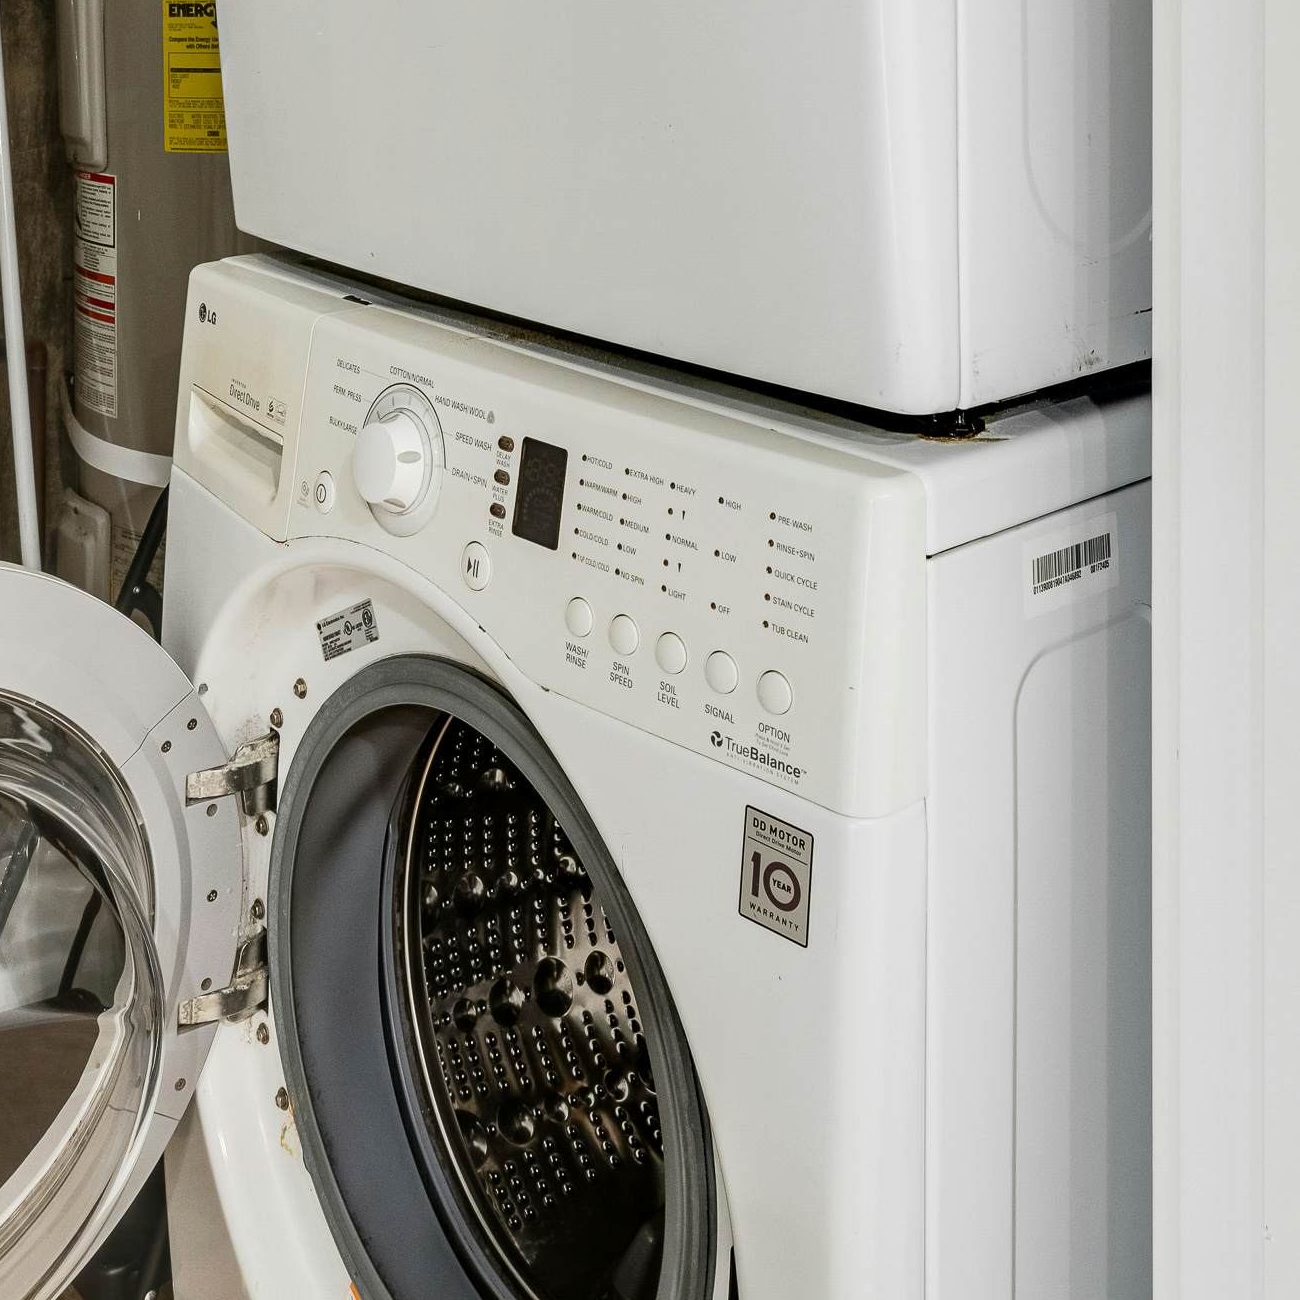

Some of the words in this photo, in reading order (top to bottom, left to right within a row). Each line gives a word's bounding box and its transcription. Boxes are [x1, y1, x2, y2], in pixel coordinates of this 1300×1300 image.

[169, 3, 217, 18] ENERG
[207, 311, 217, 325] LG
[336, 358, 360, 374] DELICATES
[347, 390, 362, 403] PRESS
[435, 395, 450, 407] HAND
[455, 432, 473, 446] SPEED
[474, 438, 492, 452] WASH
[496, 451, 511, 460] DELAY
[496, 459, 511, 468] WASH
[629, 469, 649, 482] EXTRA
[649, 475, 664, 486] HIGH
[492, 485, 508, 496] WATER
[676, 484, 696, 496] HEAVY
[493, 493, 505, 503] PLUS
[627, 494, 642, 505] HIGH
[725, 499, 741, 511] HIGH
[488, 519, 504, 530] EXTRA
[625, 520, 649, 533] MEDIUM
[778, 515, 813, 532] PRE-WASH
[488, 526, 503, 538] RINSE
[622, 544, 637, 555] LOW
[672, 535, 699, 551] NORMAL
[721, 551, 737, 563] LOW
[621, 571, 630, 580] NO
[631, 575, 645, 585] SPIN
[774, 569, 795, 582] QUICK
[796, 576, 818, 591] CYCLE
[668, 588, 686, 601] LIGHT
[718, 605, 731, 615] OFF
[772, 596, 792, 610] STAIN
[793, 604, 815, 618] CYCLE
[772, 624, 785, 635] TUB
[786, 629, 809, 643] CLEAN
[566, 641, 590, 659] WASH/
[566, 654, 586, 669] RINSE
[612, 661, 630, 676] SPIN
[609, 672, 633, 689] SPEED
[659, 681, 677, 696] SOIL
[657, 692, 680, 709] LEVEL
[704, 703, 735, 724] SIGNAL
[758, 722, 790, 743] OPTION
[753, 817, 766, 831] DD
[769, 825, 806, 850] MOTOR
[756, 830, 770, 842] Direct
[771, 837, 785, 849] Drive
[786, 844, 802, 856] Motor
[751, 851, 801, 912] 10
[772, 878, 792, 894] YEAR
[749, 901, 799, 932] WARRANTY
